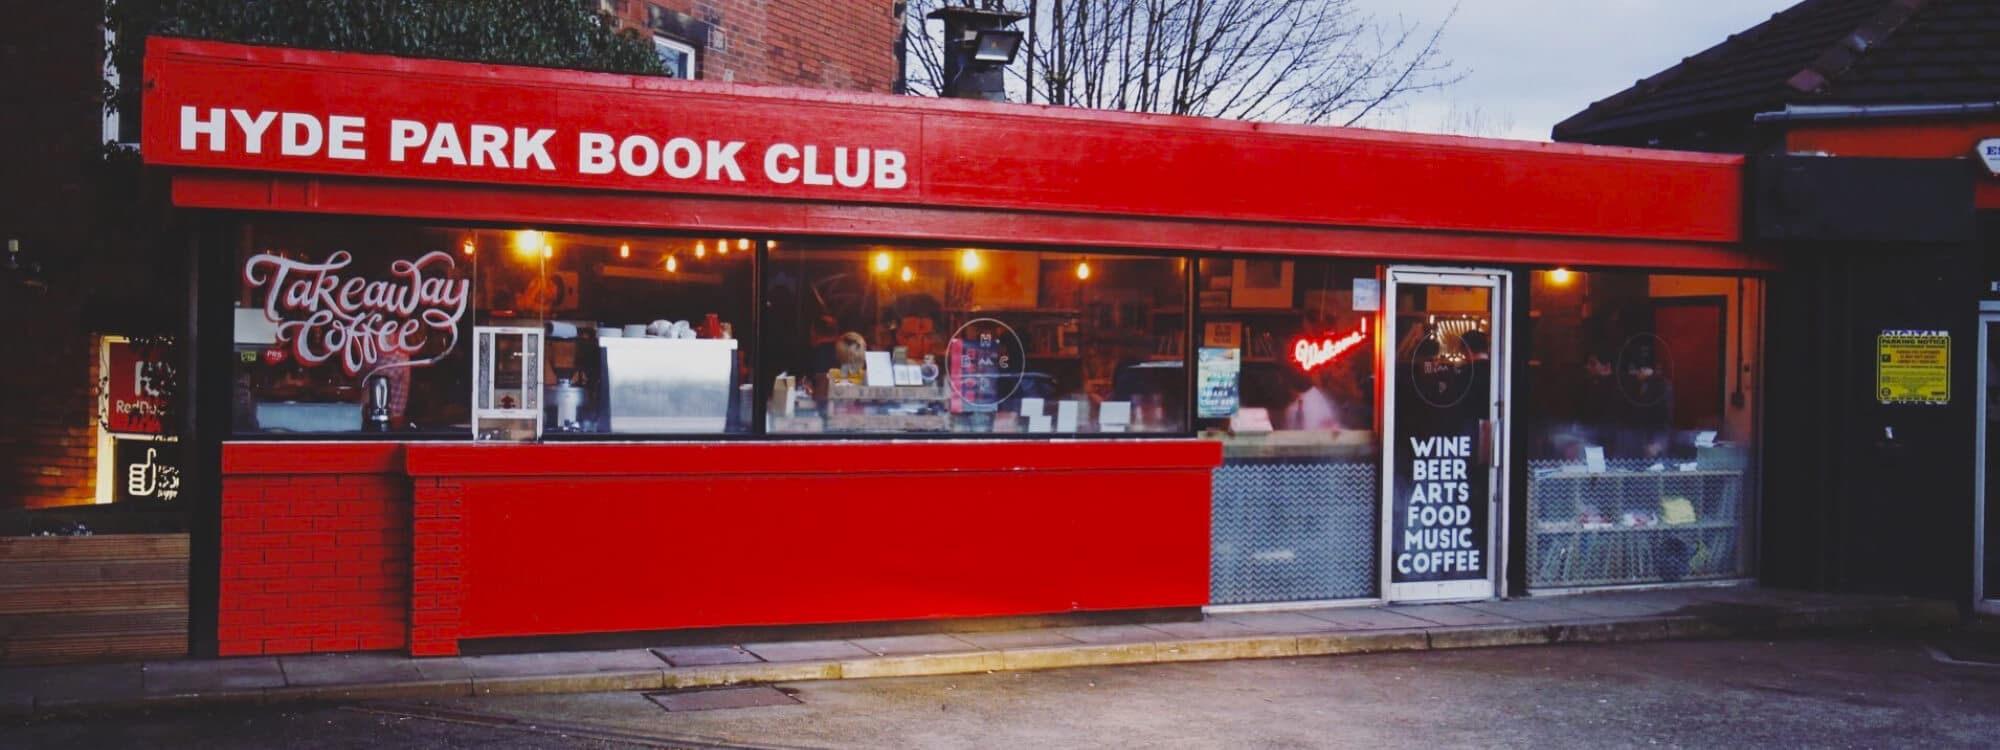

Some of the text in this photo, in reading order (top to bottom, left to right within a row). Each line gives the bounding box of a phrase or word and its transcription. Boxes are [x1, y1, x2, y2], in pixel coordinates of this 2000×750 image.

[180, 105, 908, 189] HYDE PARK BOOK CLUB
[244, 250, 470, 335] Takeaway
[276, 310, 428, 374] Coffee
[1409, 436, 1471, 457] WINE
[1413, 459, 1468, 481] BEER
[1410, 482, 1469, 504] ARTS
[1407, 505, 1471, 527] FOOD
[1404, 528, 1473, 551] MUSIC
[1397, 550, 1480, 574] COFFEE
